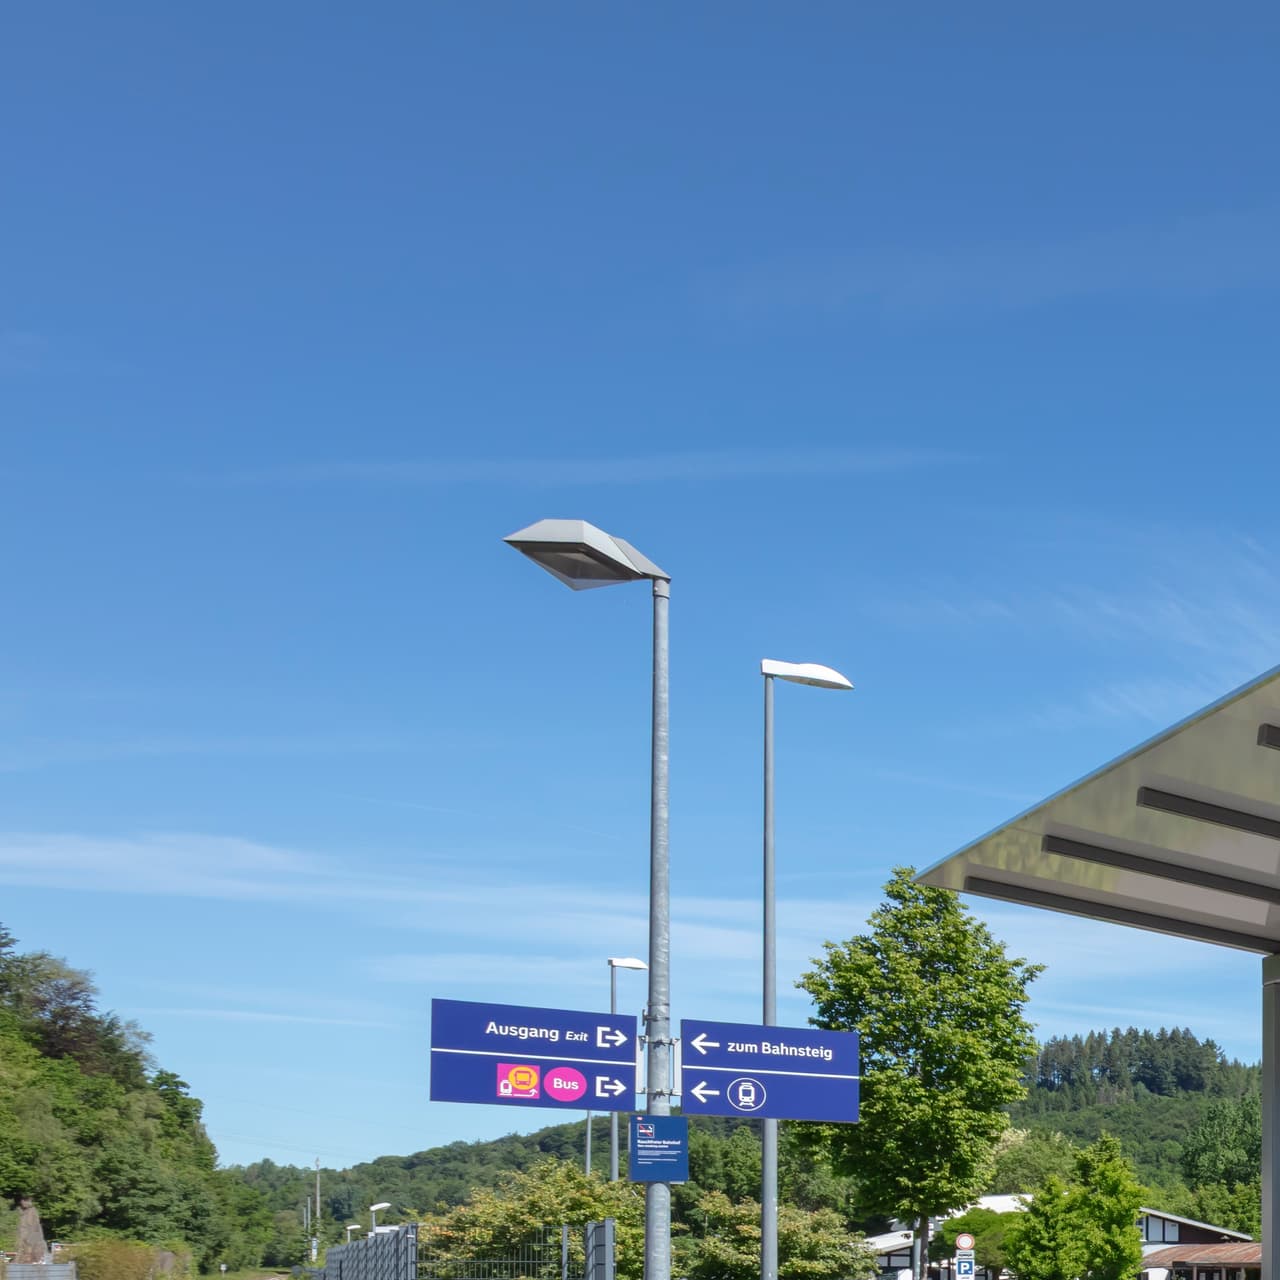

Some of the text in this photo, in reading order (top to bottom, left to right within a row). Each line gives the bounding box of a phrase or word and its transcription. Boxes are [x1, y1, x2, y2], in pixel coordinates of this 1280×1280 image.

[485, 1021, 588, 1042] Ausgang Exit
[727, 1042, 833, 1061] zum Bahnsteig
[553, 1078, 579, 1090] Bus
